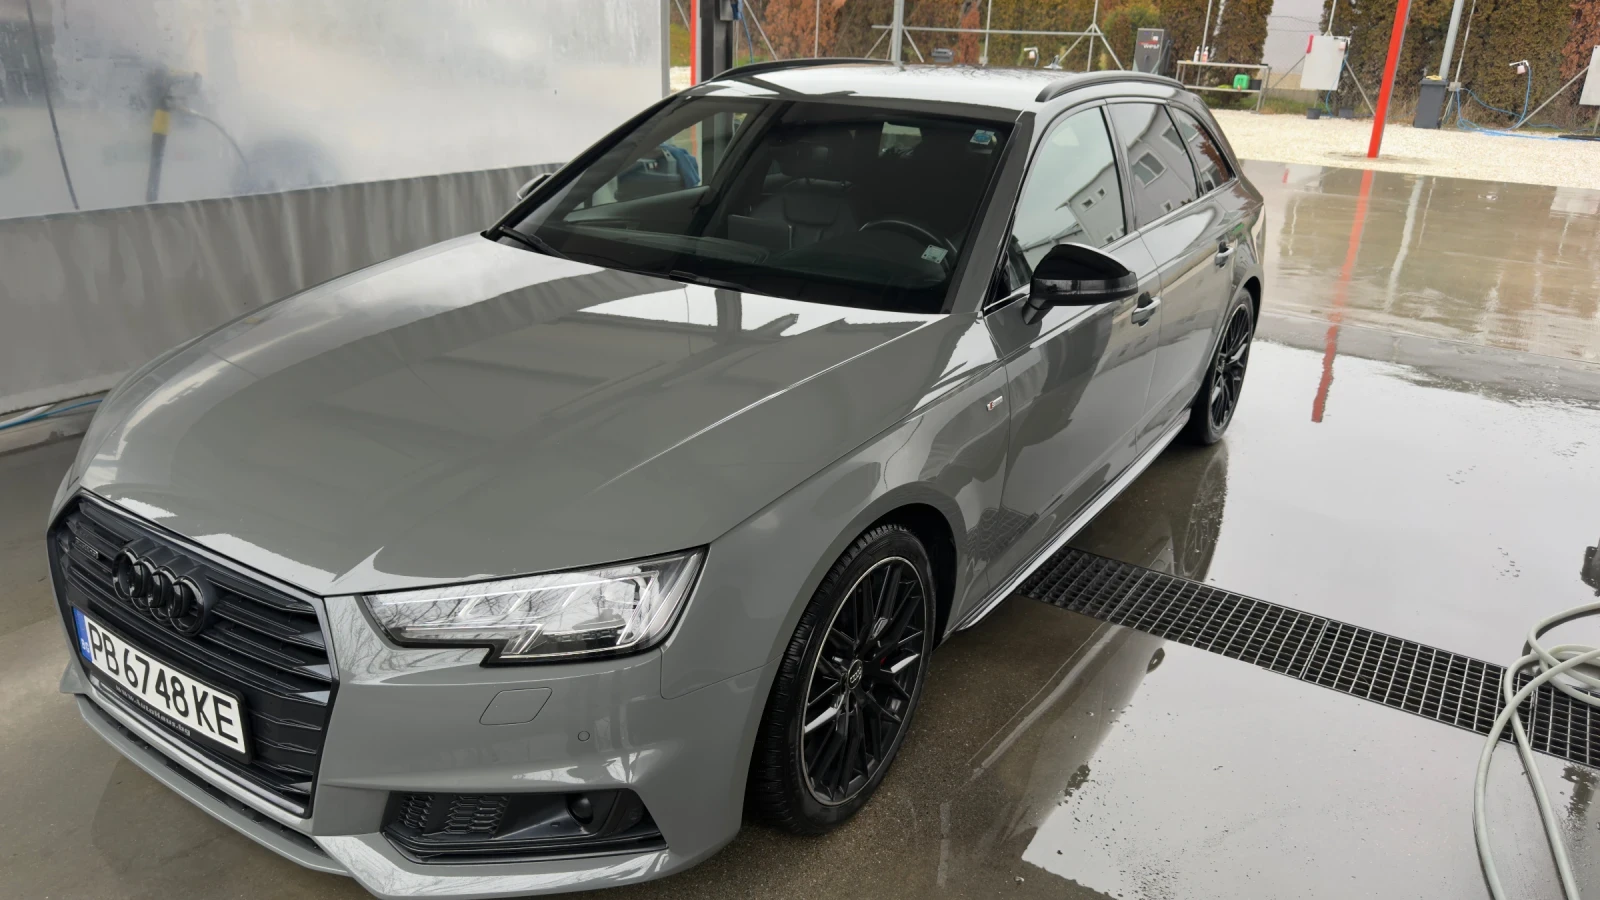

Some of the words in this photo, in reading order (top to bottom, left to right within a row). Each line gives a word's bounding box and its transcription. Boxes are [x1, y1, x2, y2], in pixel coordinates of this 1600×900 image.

[88, 622, 120, 676] PB
[123, 649, 189, 718] 6748
[193, 685, 239, 744] KE
